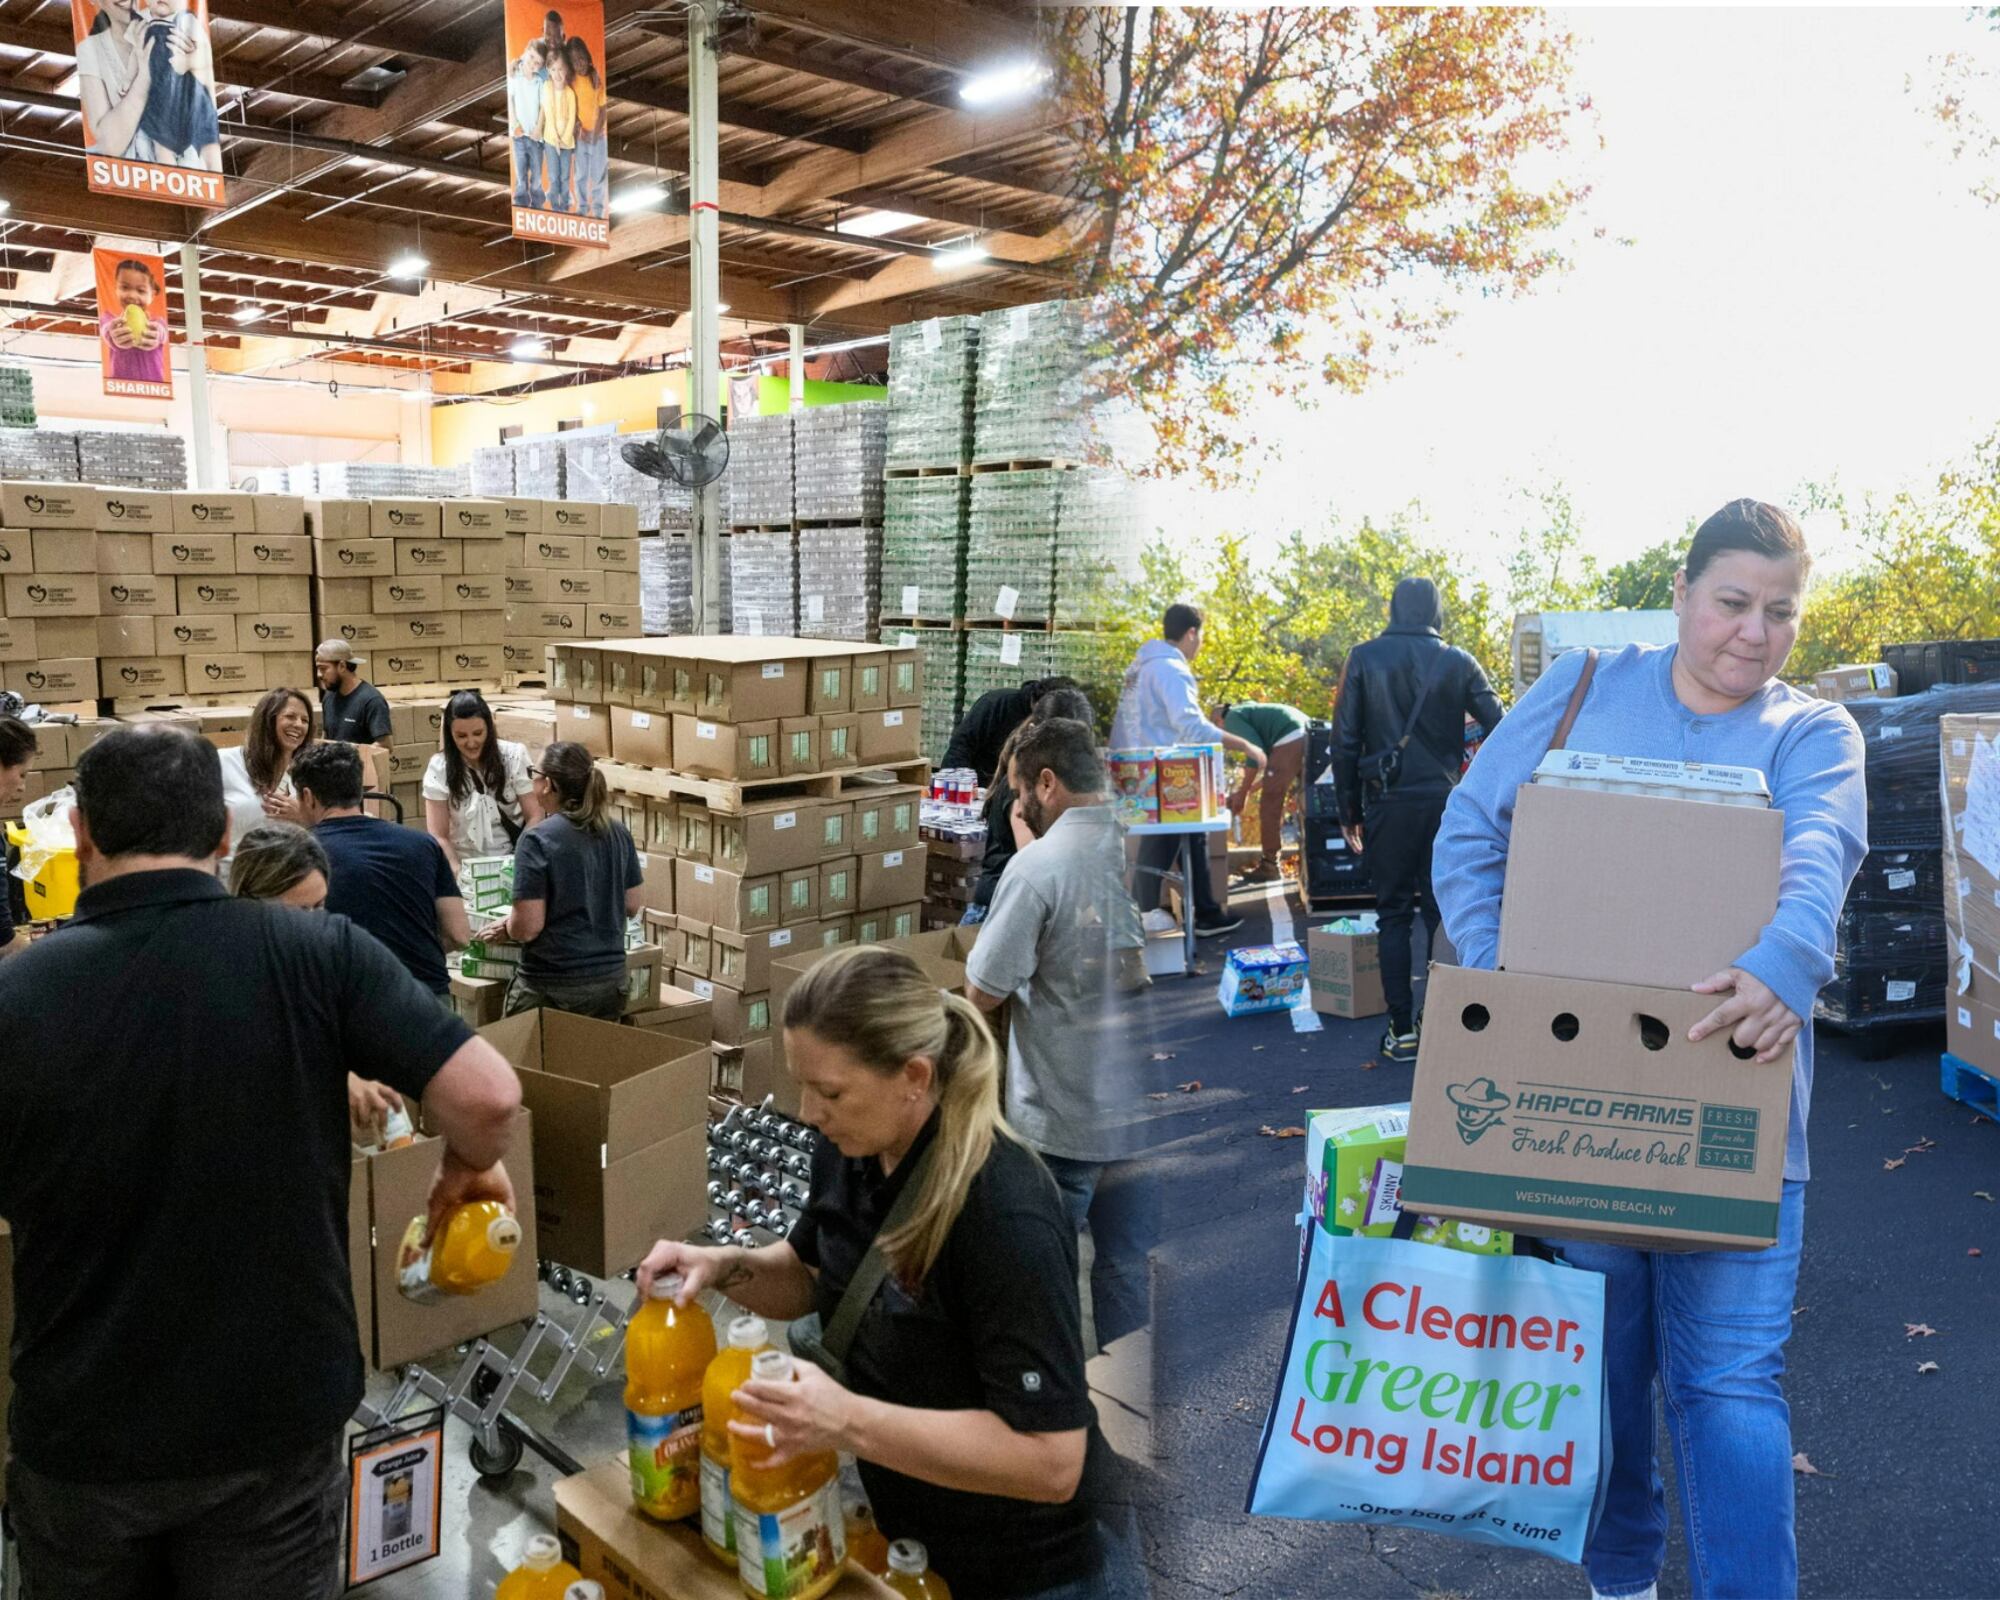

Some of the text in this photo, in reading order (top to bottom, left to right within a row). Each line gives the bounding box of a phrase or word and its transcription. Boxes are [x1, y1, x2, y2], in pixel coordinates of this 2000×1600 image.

[93, 161, 219, 200] SUPPORT
[515, 211, 607, 241] ENCOURAGE
[107, 381, 170, 396] SHARING
[1516, 1092, 1694, 1126] HAPCO FARMS
[1707, 1110, 1753, 1125] FRESH
[1512, 1127, 1692, 1167] Fresh Produce Pack
[1379, 1173, 1399, 1212] SKINNY
[1515, 1190, 1676, 1216] WESTHAMPTON BEACH, NY
[1313, 1279, 1585, 1363] A Cleaner,
[1304, 1339, 1581, 1432] Greener
[1290, 1396, 1575, 1486] Long Island
[1410, 1508, 1456, 1524] bag
[1491, 1516, 1507, 1526] a
[1512, 1521, 1562, 1541] time
[370, 1533, 424, 1562] 1 Bottle
